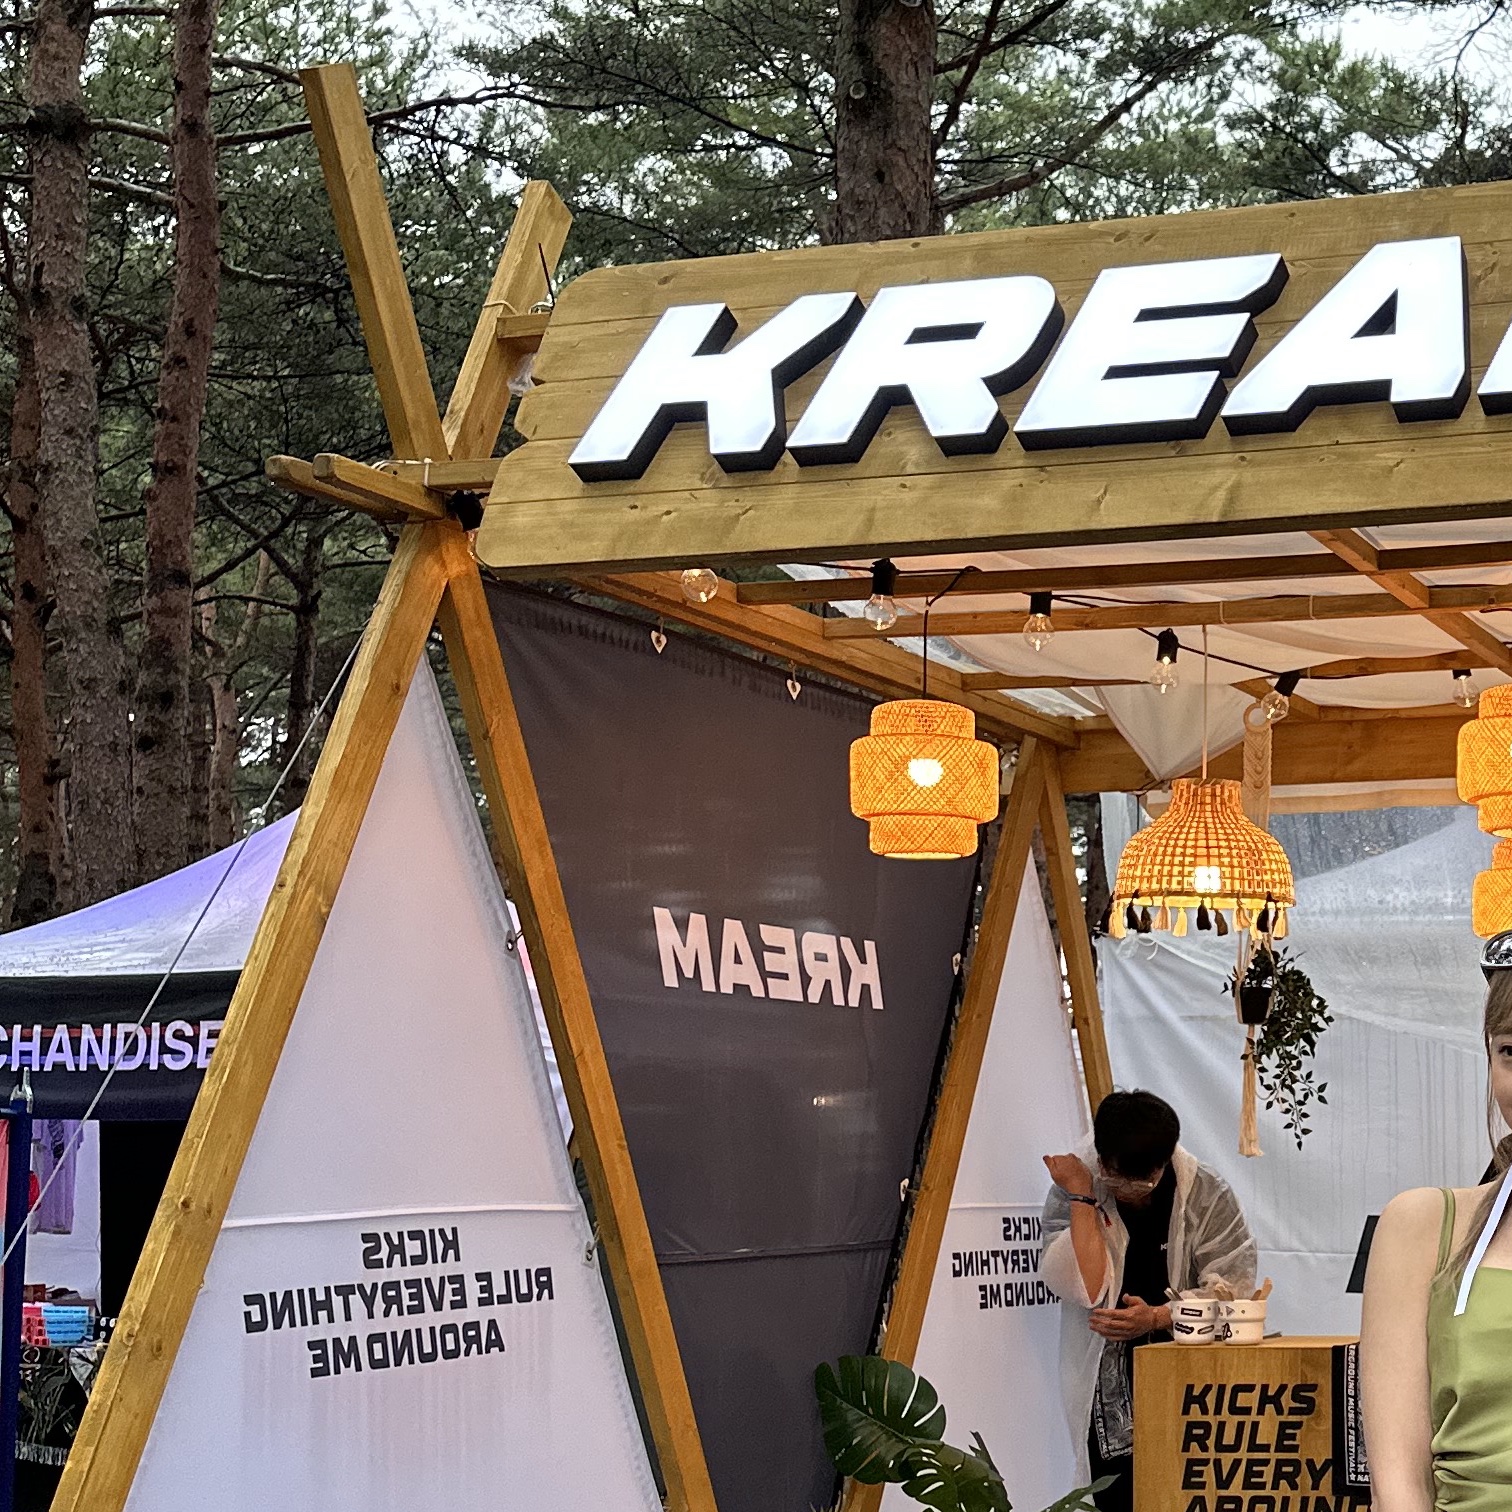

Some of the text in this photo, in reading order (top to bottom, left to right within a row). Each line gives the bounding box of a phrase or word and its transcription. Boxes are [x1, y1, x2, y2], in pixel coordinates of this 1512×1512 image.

[0, 1019, 225, 1072] HANDISE
[1181, 1383, 1319, 1416] KICKS
[1181, 1420, 1304, 1453] RULE
[1348, 1428, 1356, 1473] FESTIVAL
[1181, 1458, 1333, 1491] EVERY
